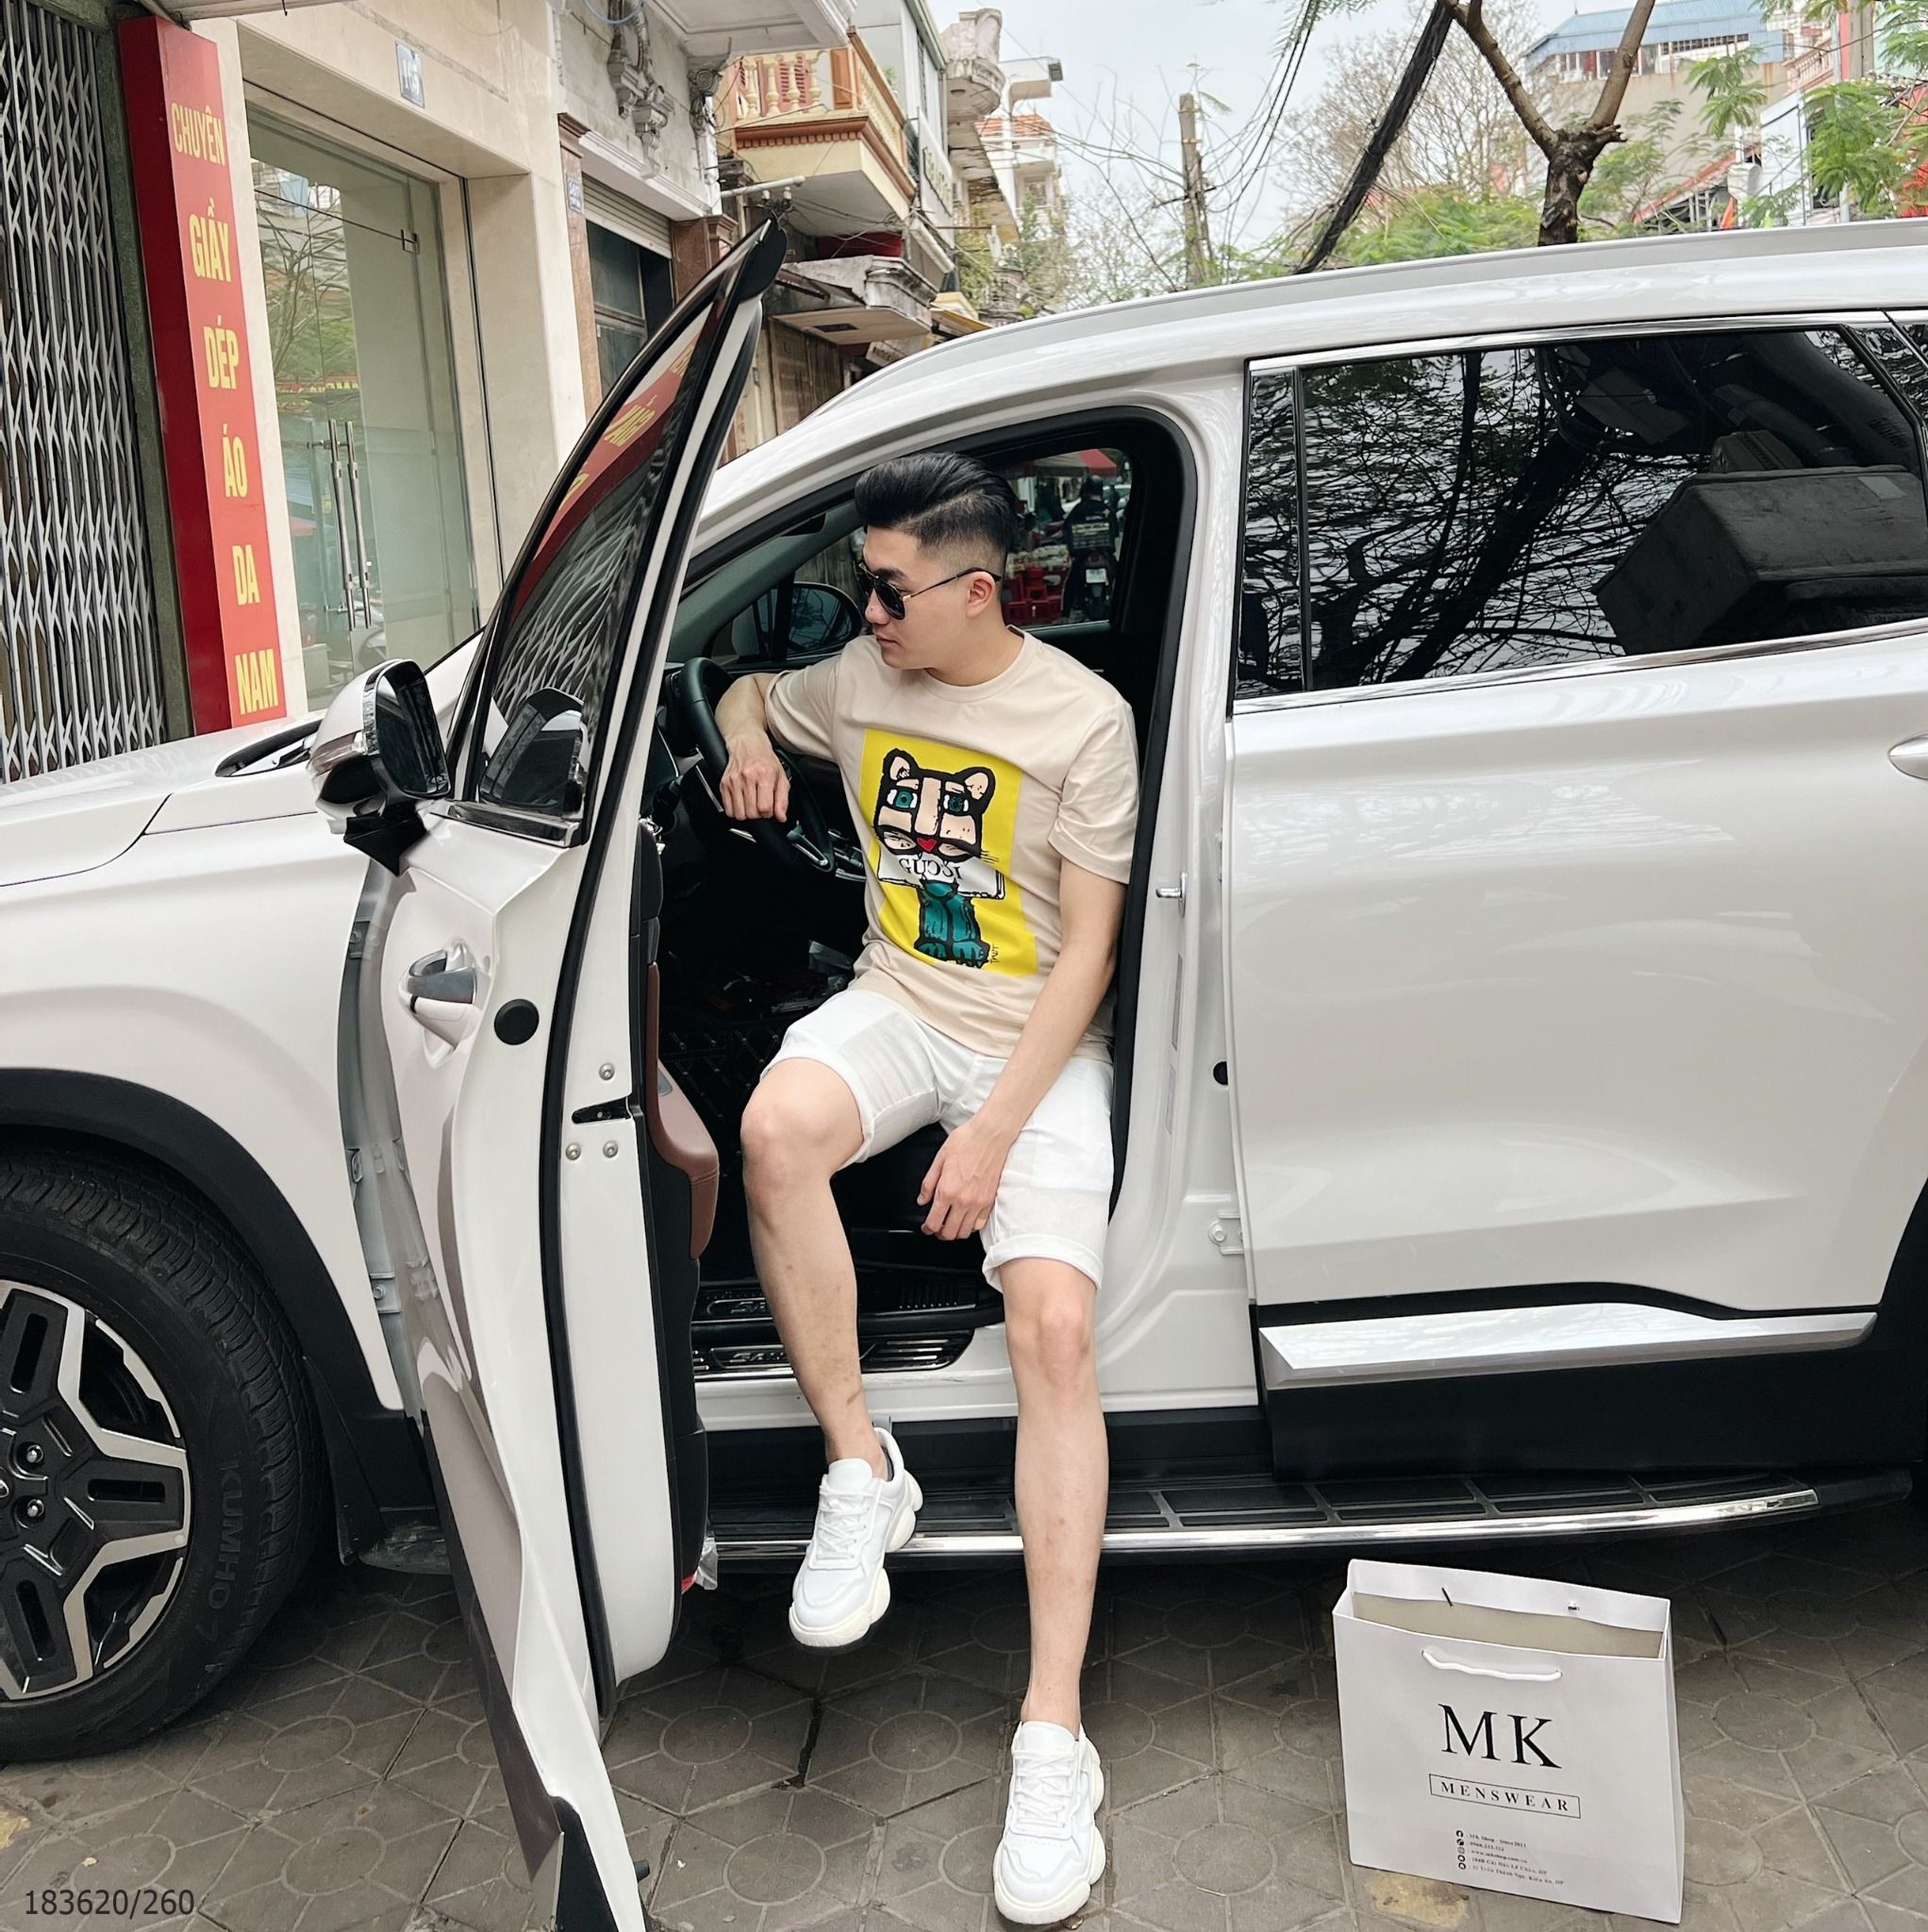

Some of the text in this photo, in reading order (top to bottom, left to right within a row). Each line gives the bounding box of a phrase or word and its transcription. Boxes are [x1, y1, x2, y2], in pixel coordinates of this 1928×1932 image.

[171, 102, 225, 166] CHUYÊN
[189, 197, 232, 282] GIẦY
[203, 314, 240, 390] DÉP
[222, 423, 248, 498] ÁO
[232, 544, 260, 606] DA
[235, 649, 279, 715] NAM
[208, 1458, 244, 1609] KUMHO
[1438, 1703, 1563, 1770] MK
[1440, 1781, 1569, 1812] MENSWEAR
